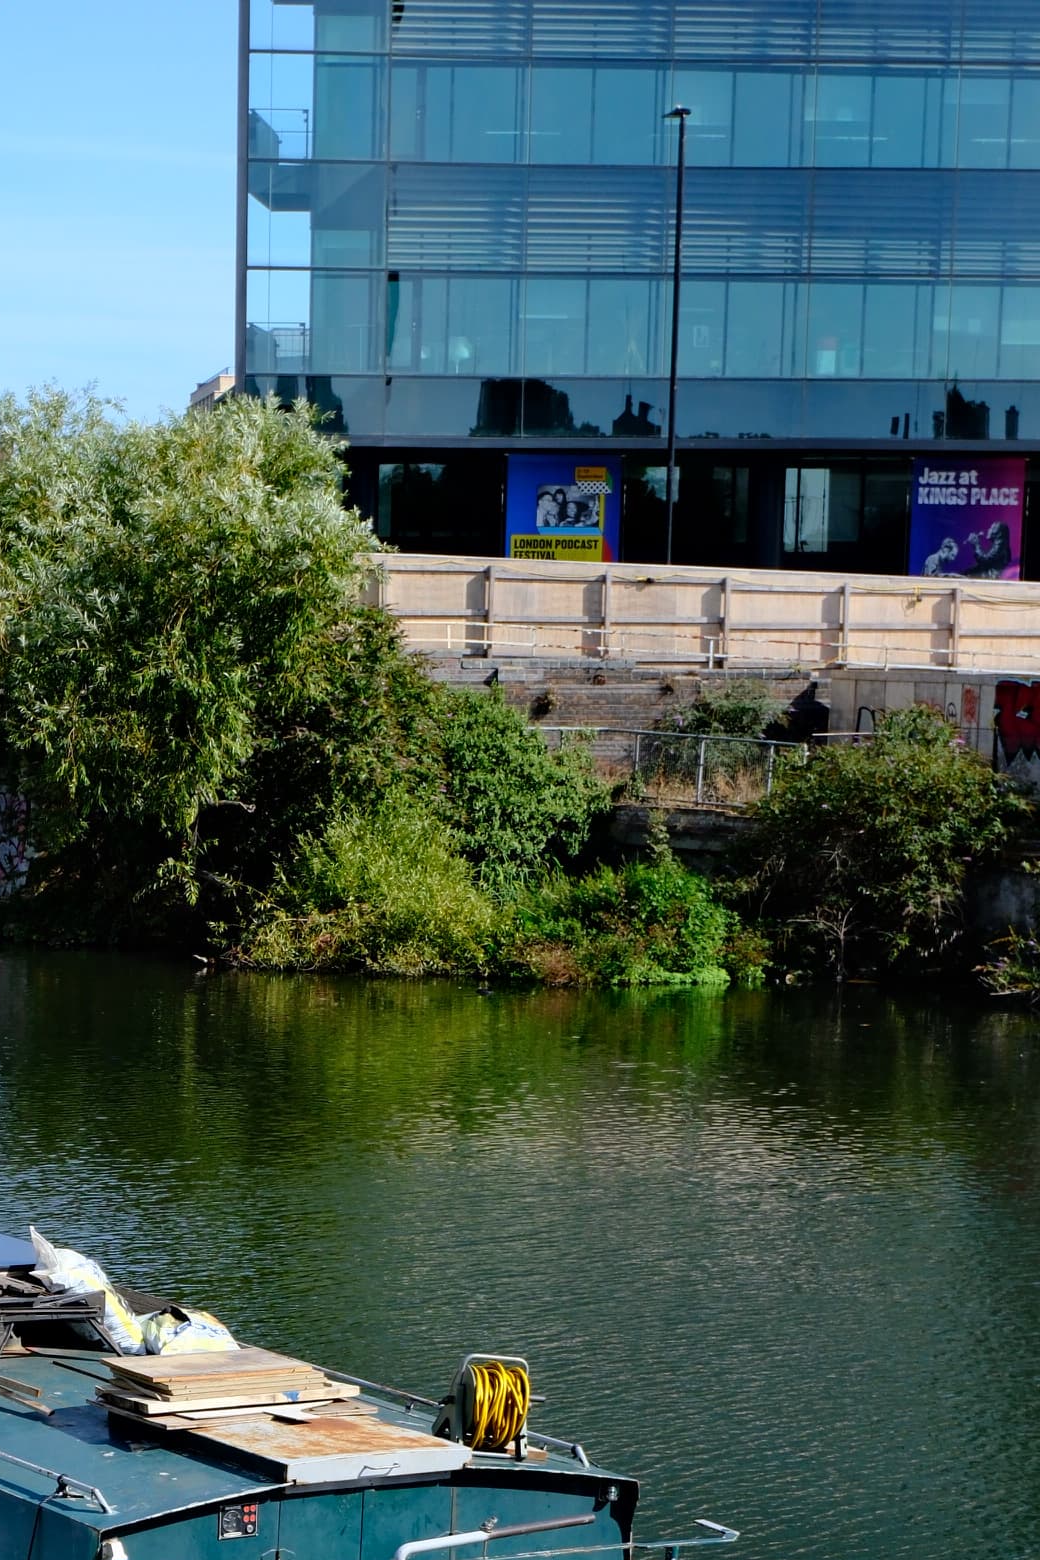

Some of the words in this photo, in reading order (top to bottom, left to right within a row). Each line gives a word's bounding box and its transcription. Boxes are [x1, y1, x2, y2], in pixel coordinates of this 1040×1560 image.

[918, 467, 957, 485] Jazz
[958, 469, 979, 485] at
[917, 487, 968, 506] KINGS
[970, 487, 1020, 506] PLACE
[514, 538, 553, 550] LONDON
[555, 539, 600, 550] PODCAST
[514, 550, 557, 561] FESTIVAL
